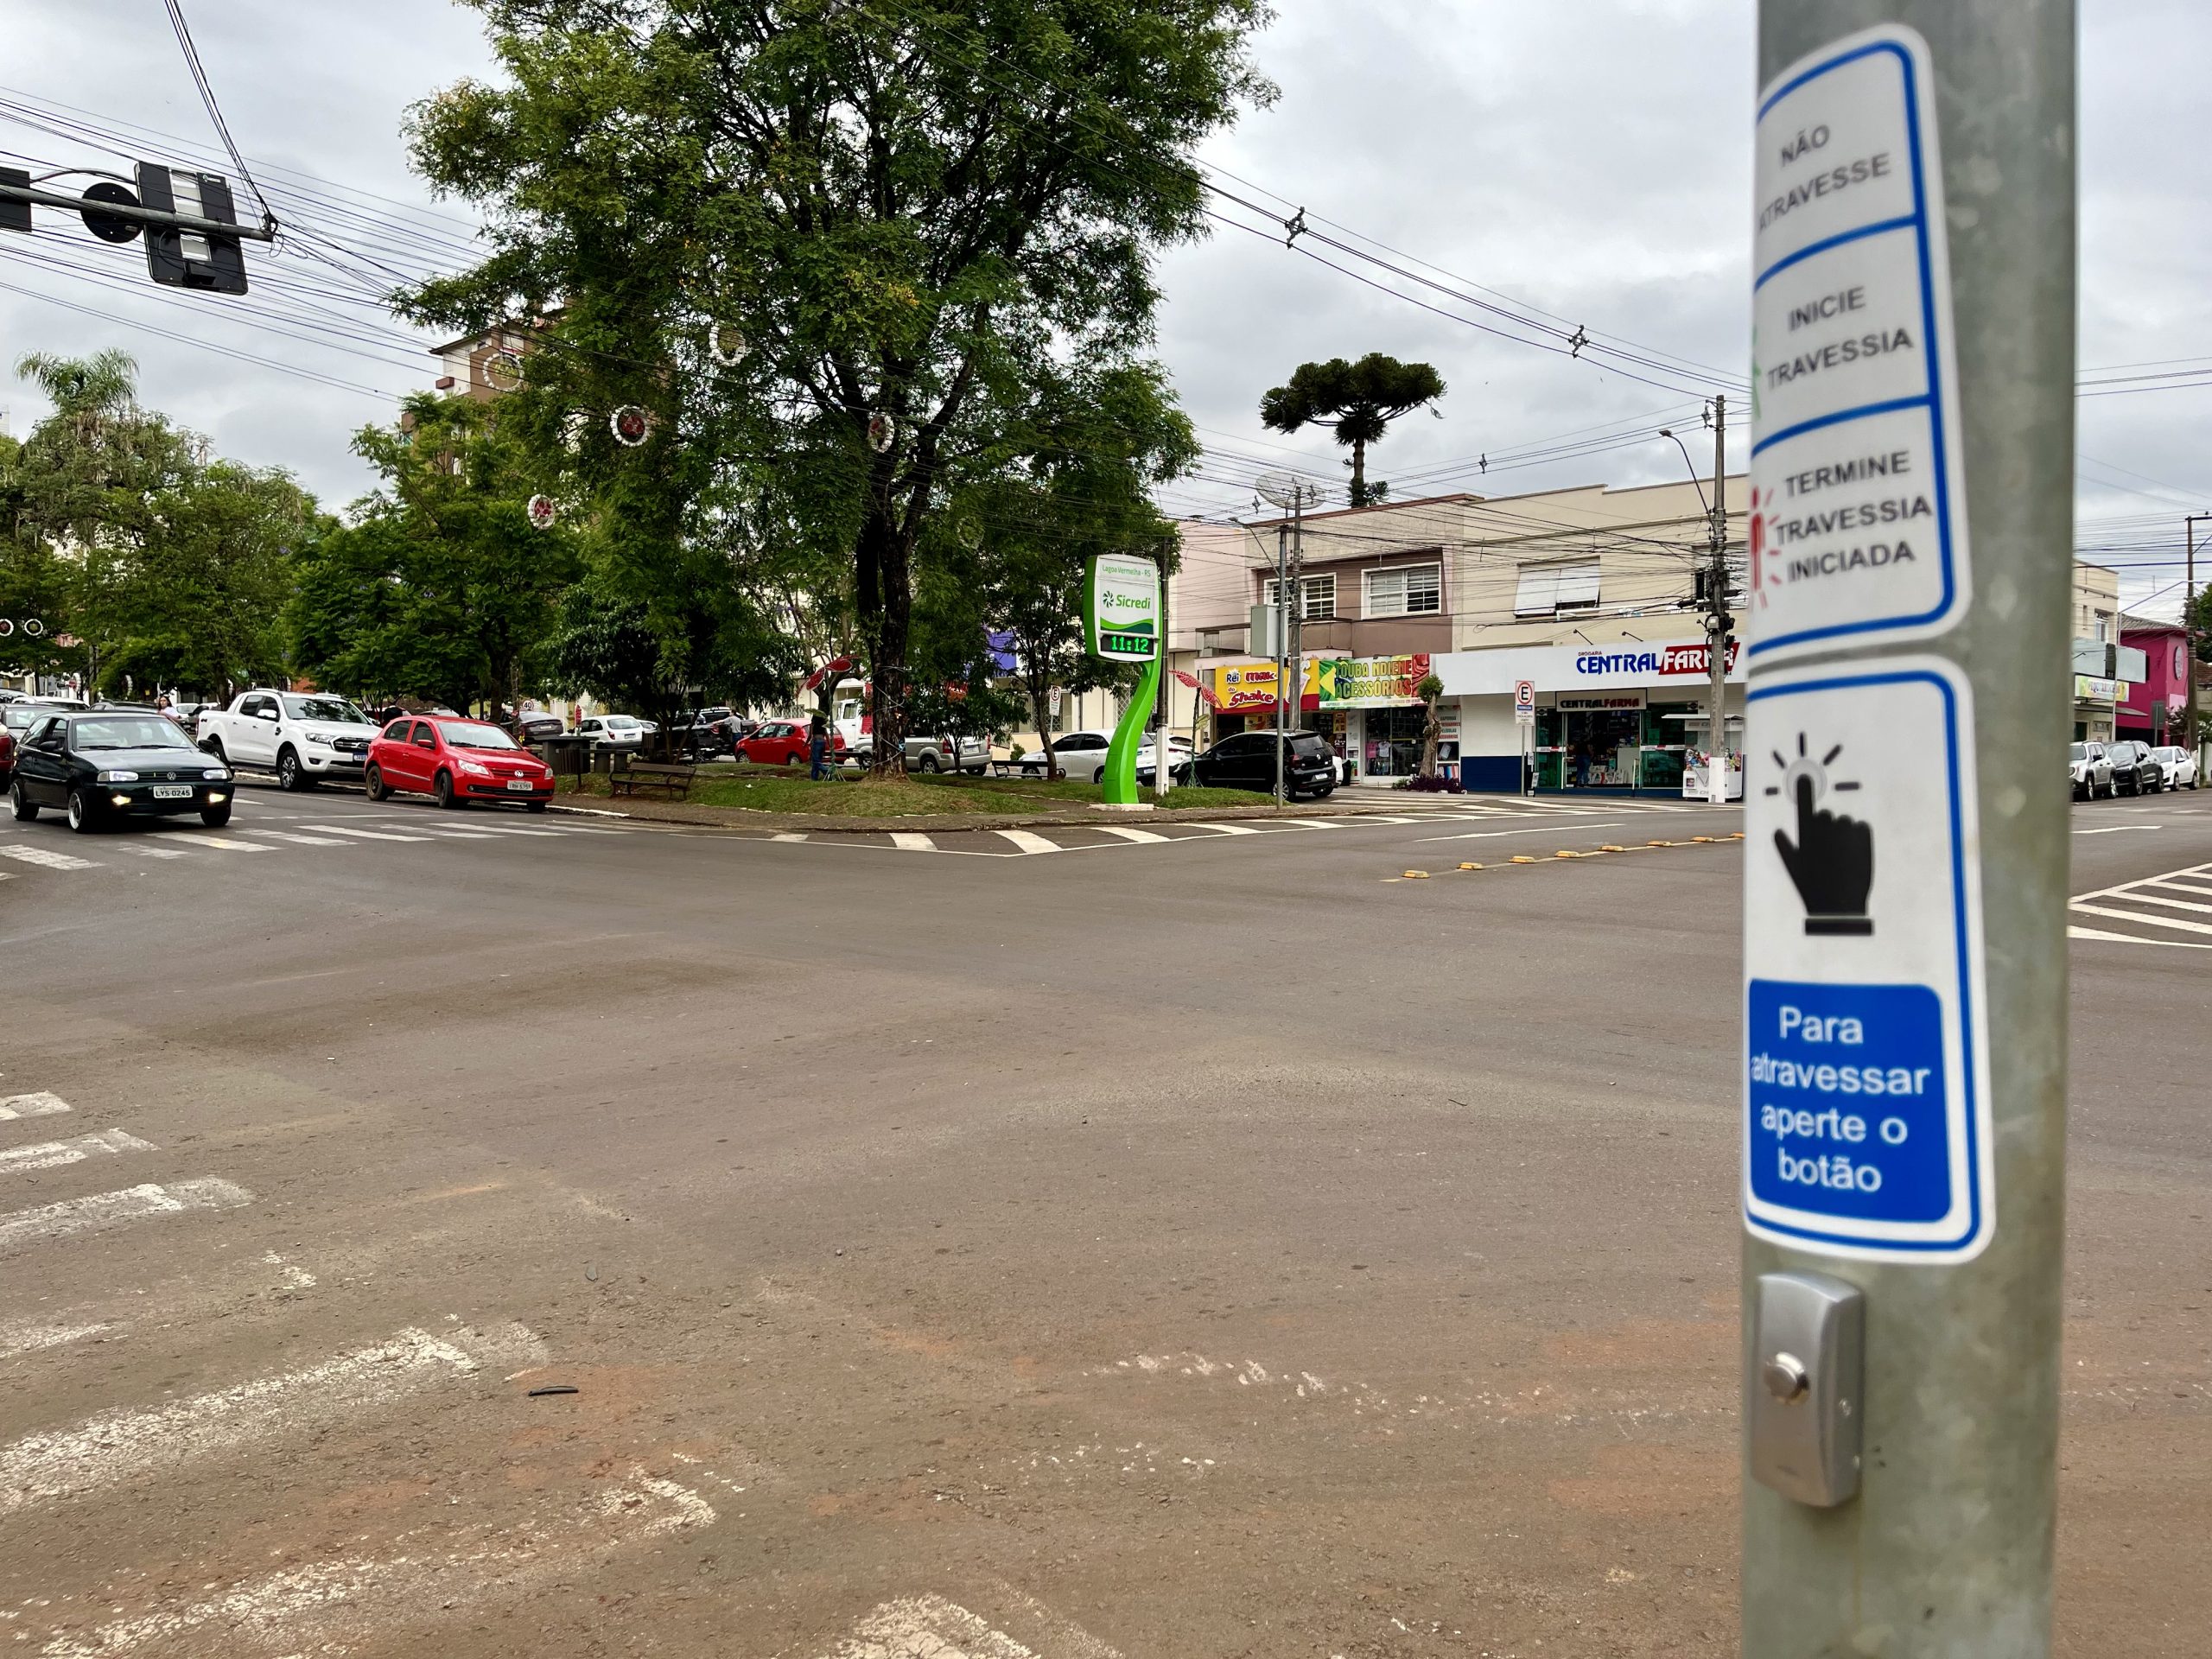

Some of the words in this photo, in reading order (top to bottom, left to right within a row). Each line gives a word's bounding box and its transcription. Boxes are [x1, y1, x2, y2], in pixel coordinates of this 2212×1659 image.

[1780, 124, 1830, 168] NÃO
[1759, 152, 1891, 235] ATRAVESSE
[1788, 286, 1866, 333] INICIE
[1767, 328, 1914, 391] TRAVESSIA
[1785, 450, 1911, 498] TERMINE
[1777, 495, 1933, 546] TRAVESSIA
[1102, 564, 1117, 575] Lagoa
[1118, 566, 1141, 576] Vermelha
[1144, 569, 1151, 577] RS
[1787, 541, 1916, 583] INICIADA
[1116, 594, 1151, 609] Sicredi
[1111, 636, 1148, 652] 11:12
[1226, 672, 1239, 683] Rei
[1335, 677, 1412, 699] ACESSÓRIOS
[1336, 663, 1369, 678] TOUBA
[1372, 659, 1412, 676] NDIENE
[1521, 686, 1529, 700] E
[1779, 1005, 1865, 1045] Para
[1751, 1052, 1931, 1095] atravessar
[1760, 1103, 1867, 1142] aperte
[1878, 1116, 1909, 1146] o
[1777, 1147, 1883, 1193] botão
